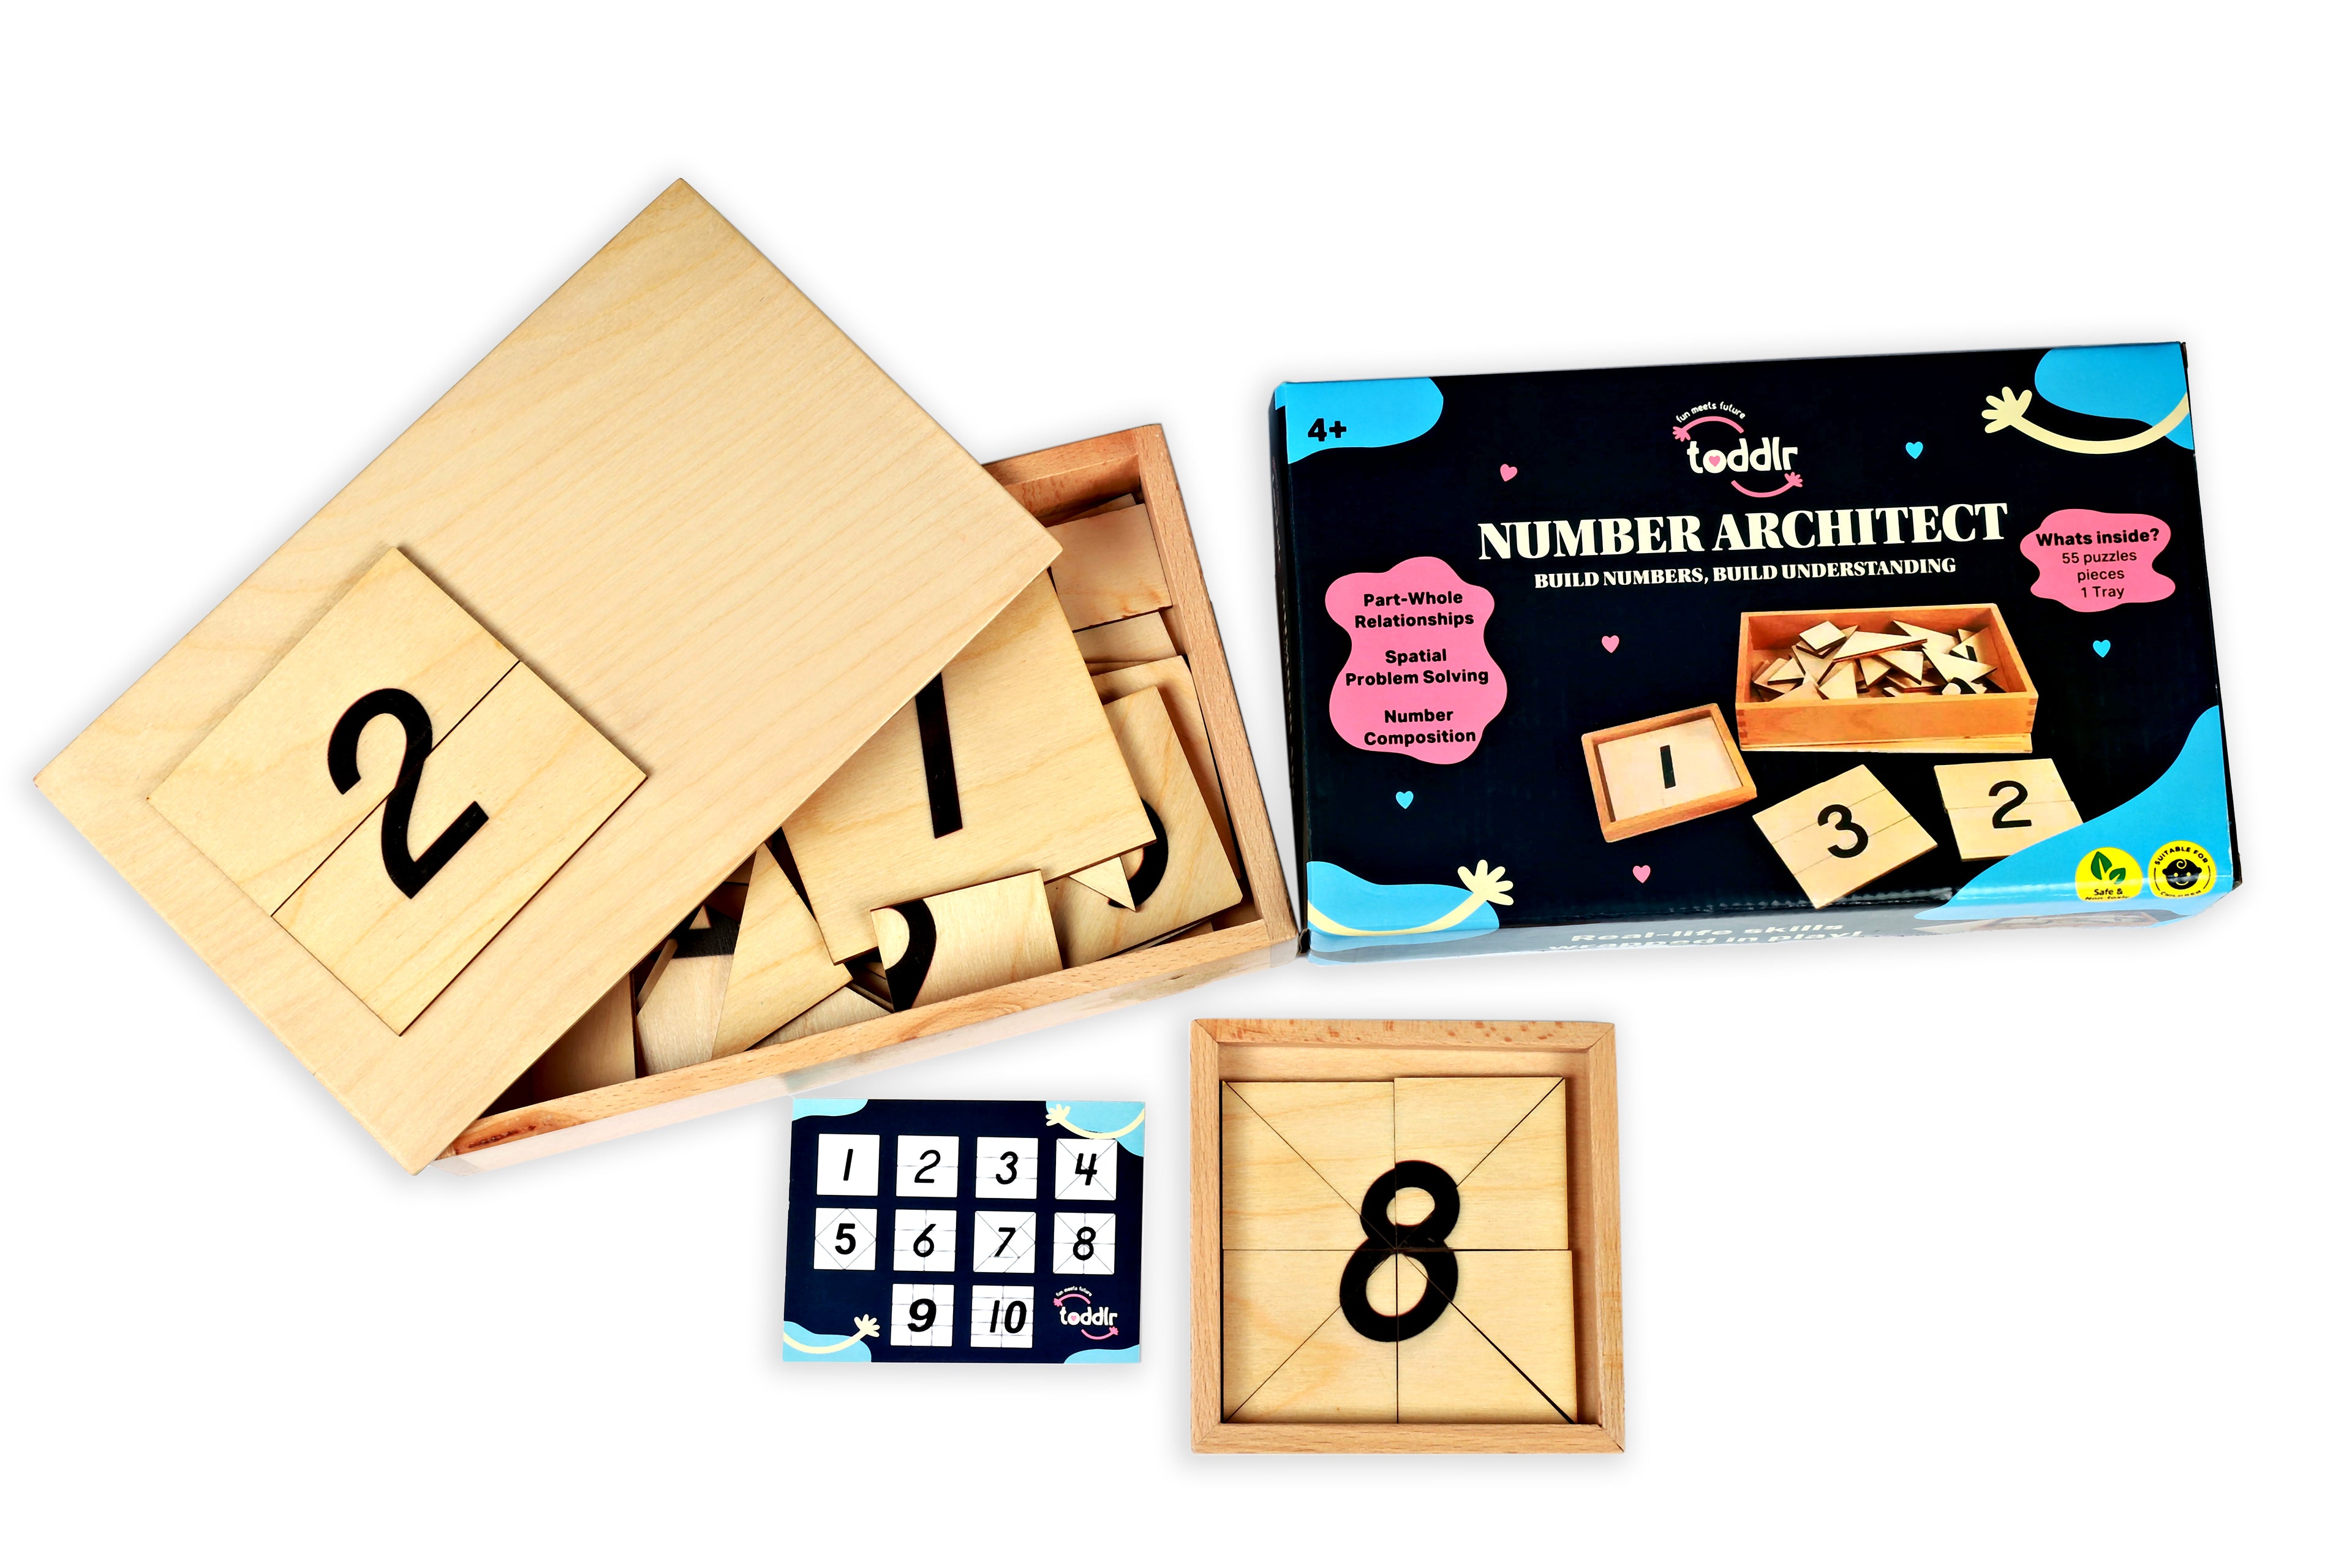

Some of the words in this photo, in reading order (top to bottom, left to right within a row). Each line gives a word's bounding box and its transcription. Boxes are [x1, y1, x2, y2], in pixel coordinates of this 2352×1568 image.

[1676, 412, 1691, 423] fun
[1691, 401, 1716, 414] meets
[1719, 401, 1746, 419] future
[1307, 418, 1347, 442] 4+
[1687, 437, 1798, 473] toddlr
[1478, 515, 1704, 560] NUMBER
[1712, 502, 2008, 552] ARCHITECT
[2036, 533, 2093, 546] Whats
[2097, 528, 2159, 544] inside?
[2062, 552, 2079, 564] 55
[2084, 551, 2137, 565] puzzles
[1534, 571, 1599, 588] BUILD
[1603, 567, 1709, 586] NUMBERS,
[1713, 564, 1777, 582] BUILD
[1782, 557, 1956, 579] UNDERSTANDING
[2078, 569, 2125, 583] pieces
[1363, 591, 1463, 607] Part-Whole
[2081, 587, 2087, 598] 1
[2092, 586, 2124, 599] Tray
[1355, 612, 1474, 628] Relationships
[1385, 648, 1447, 665] Spatial
[1346, 671, 1419, 686] Problem
[1422, 668, 1489, 685] Solving
[1384, 707, 1453, 724] Number
[1363, 729, 1476, 747] Composition
[1660, 745, 1676, 789] 1
[328, 688, 489, 899] 2
[1988, 780, 2032, 829] 2
[1817, 804, 1868, 859] 3
[2154, 846, 2191, 865] SUITABLE
[2193, 850, 2208, 864] FOR
[1571, 928, 1733, 942] Real-life
[1744, 924, 1844, 935] skills
[843, 1148, 853, 1182] 1
[914, 1150, 941, 1183] 2
[995, 1151, 1018, 1185] 3
[1075, 1153, 1097, 1186] 4
[835, 1223, 856, 1255] 5
[913, 1223, 937, 1257] 6
[993, 1227, 1016, 1258] 7
[1073, 1226, 1096, 1261] 8
[1339, 1159, 1460, 1343] 8
[908, 1298, 937, 1332] 9
[990, 1300, 1027, 1333] 10
[1060, 1306, 1118, 1325] toddlr
